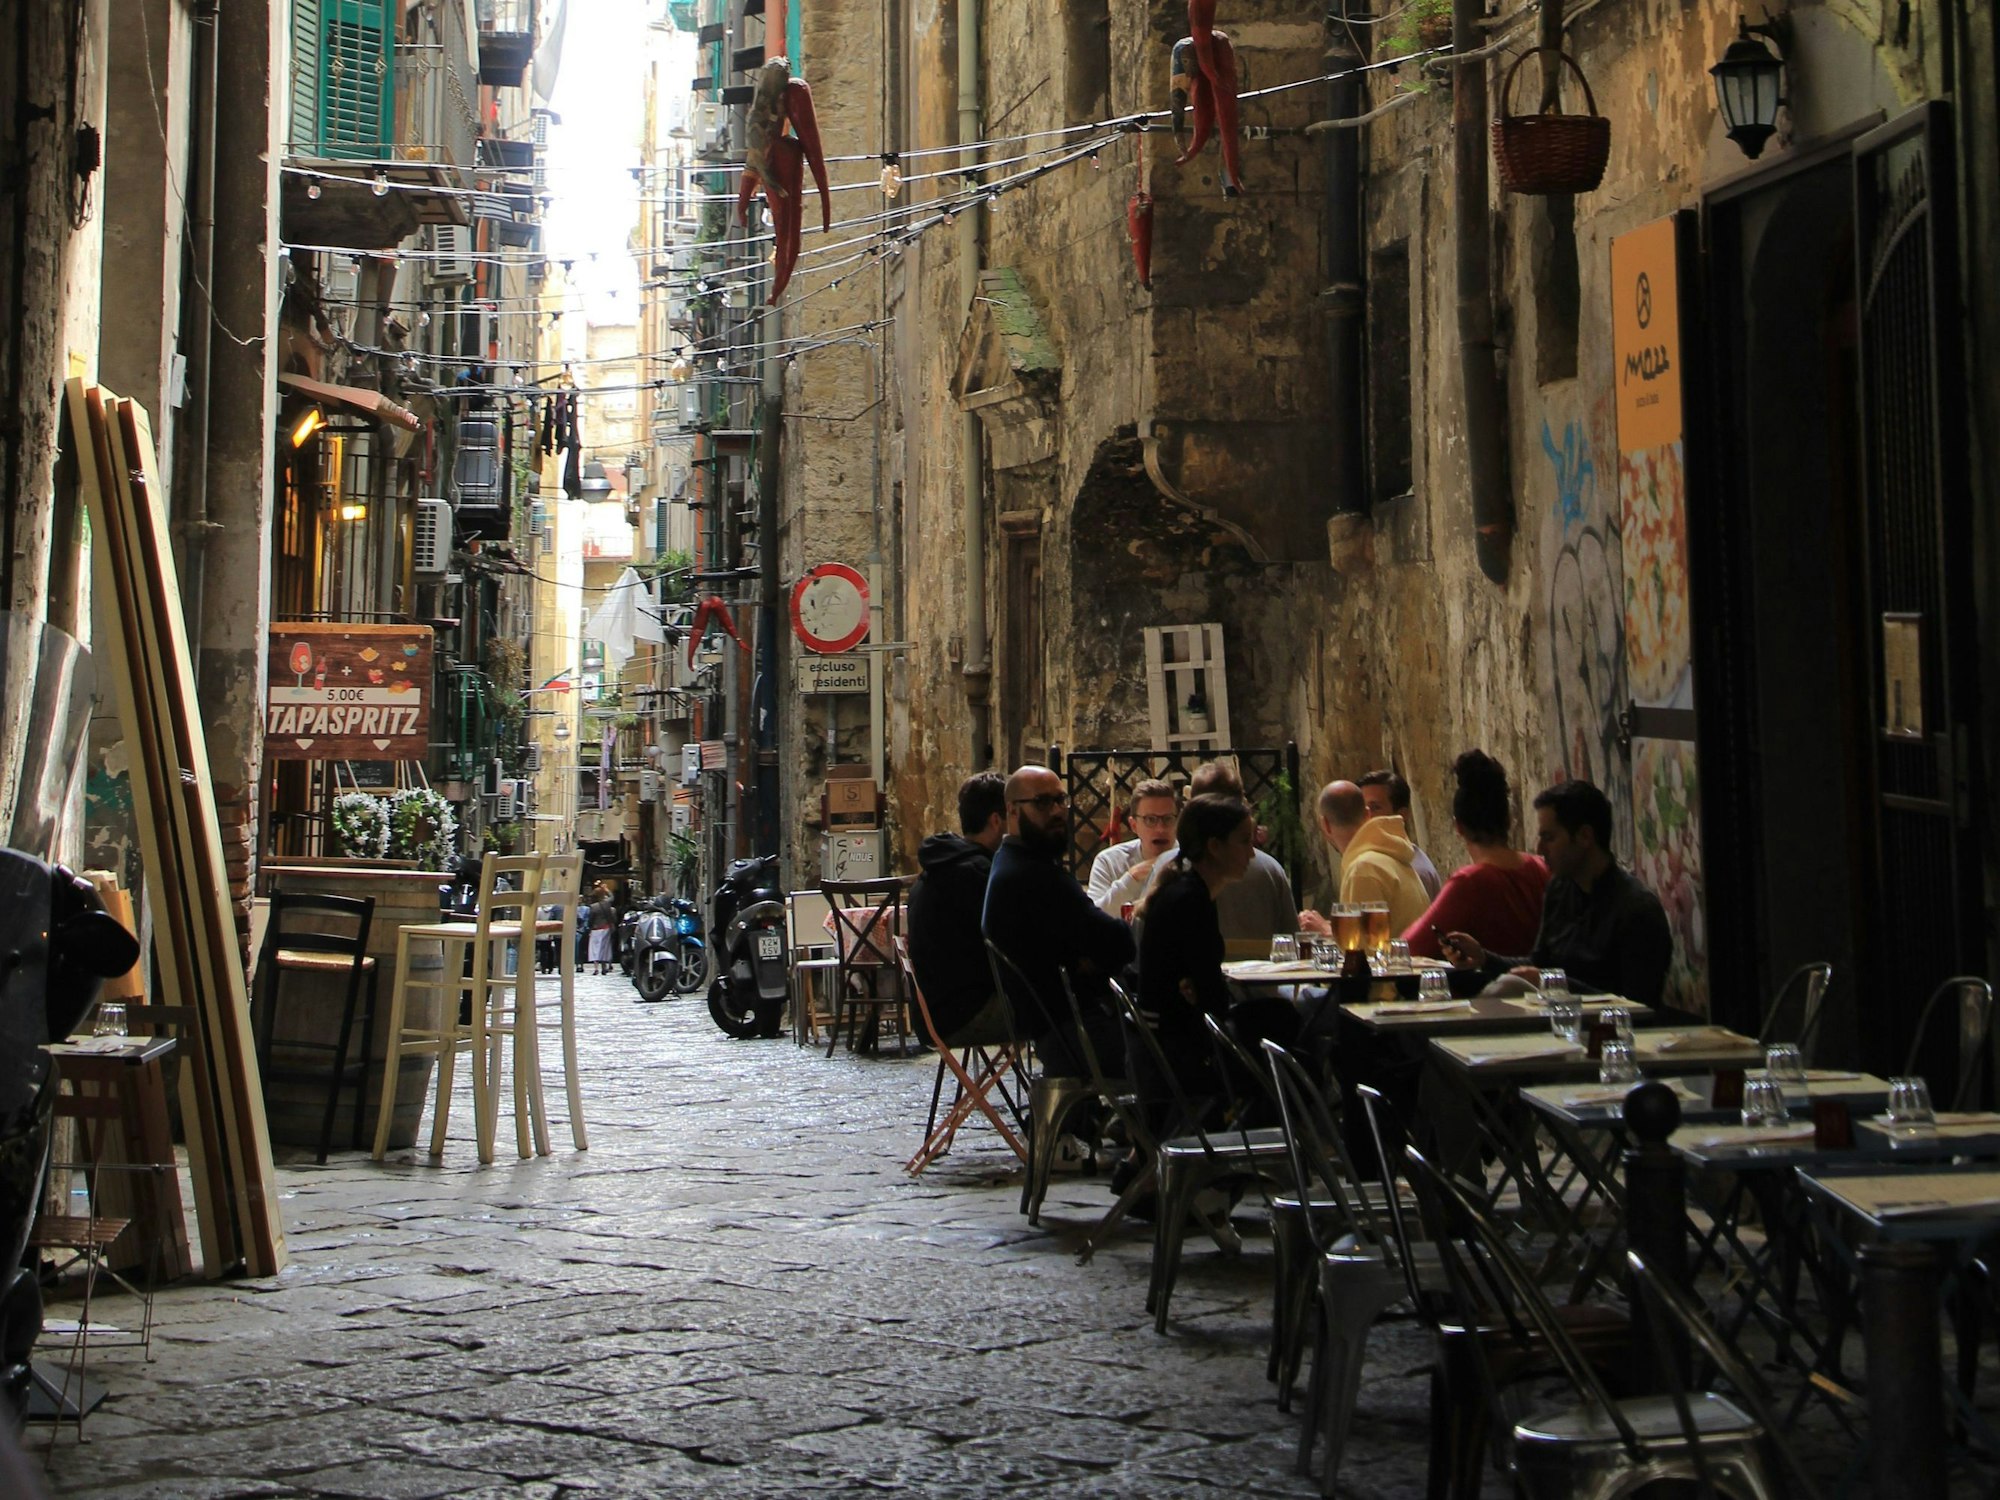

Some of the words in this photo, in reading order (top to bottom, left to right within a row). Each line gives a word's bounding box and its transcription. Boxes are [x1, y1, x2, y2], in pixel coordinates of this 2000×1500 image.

[809, 661, 856, 672] escluso
[812, 676, 866, 687] residenti
[327, 689, 365, 702] 5,00€
[268, 706, 420, 735] TAPASPRITZ
[847, 787, 858, 800] S
